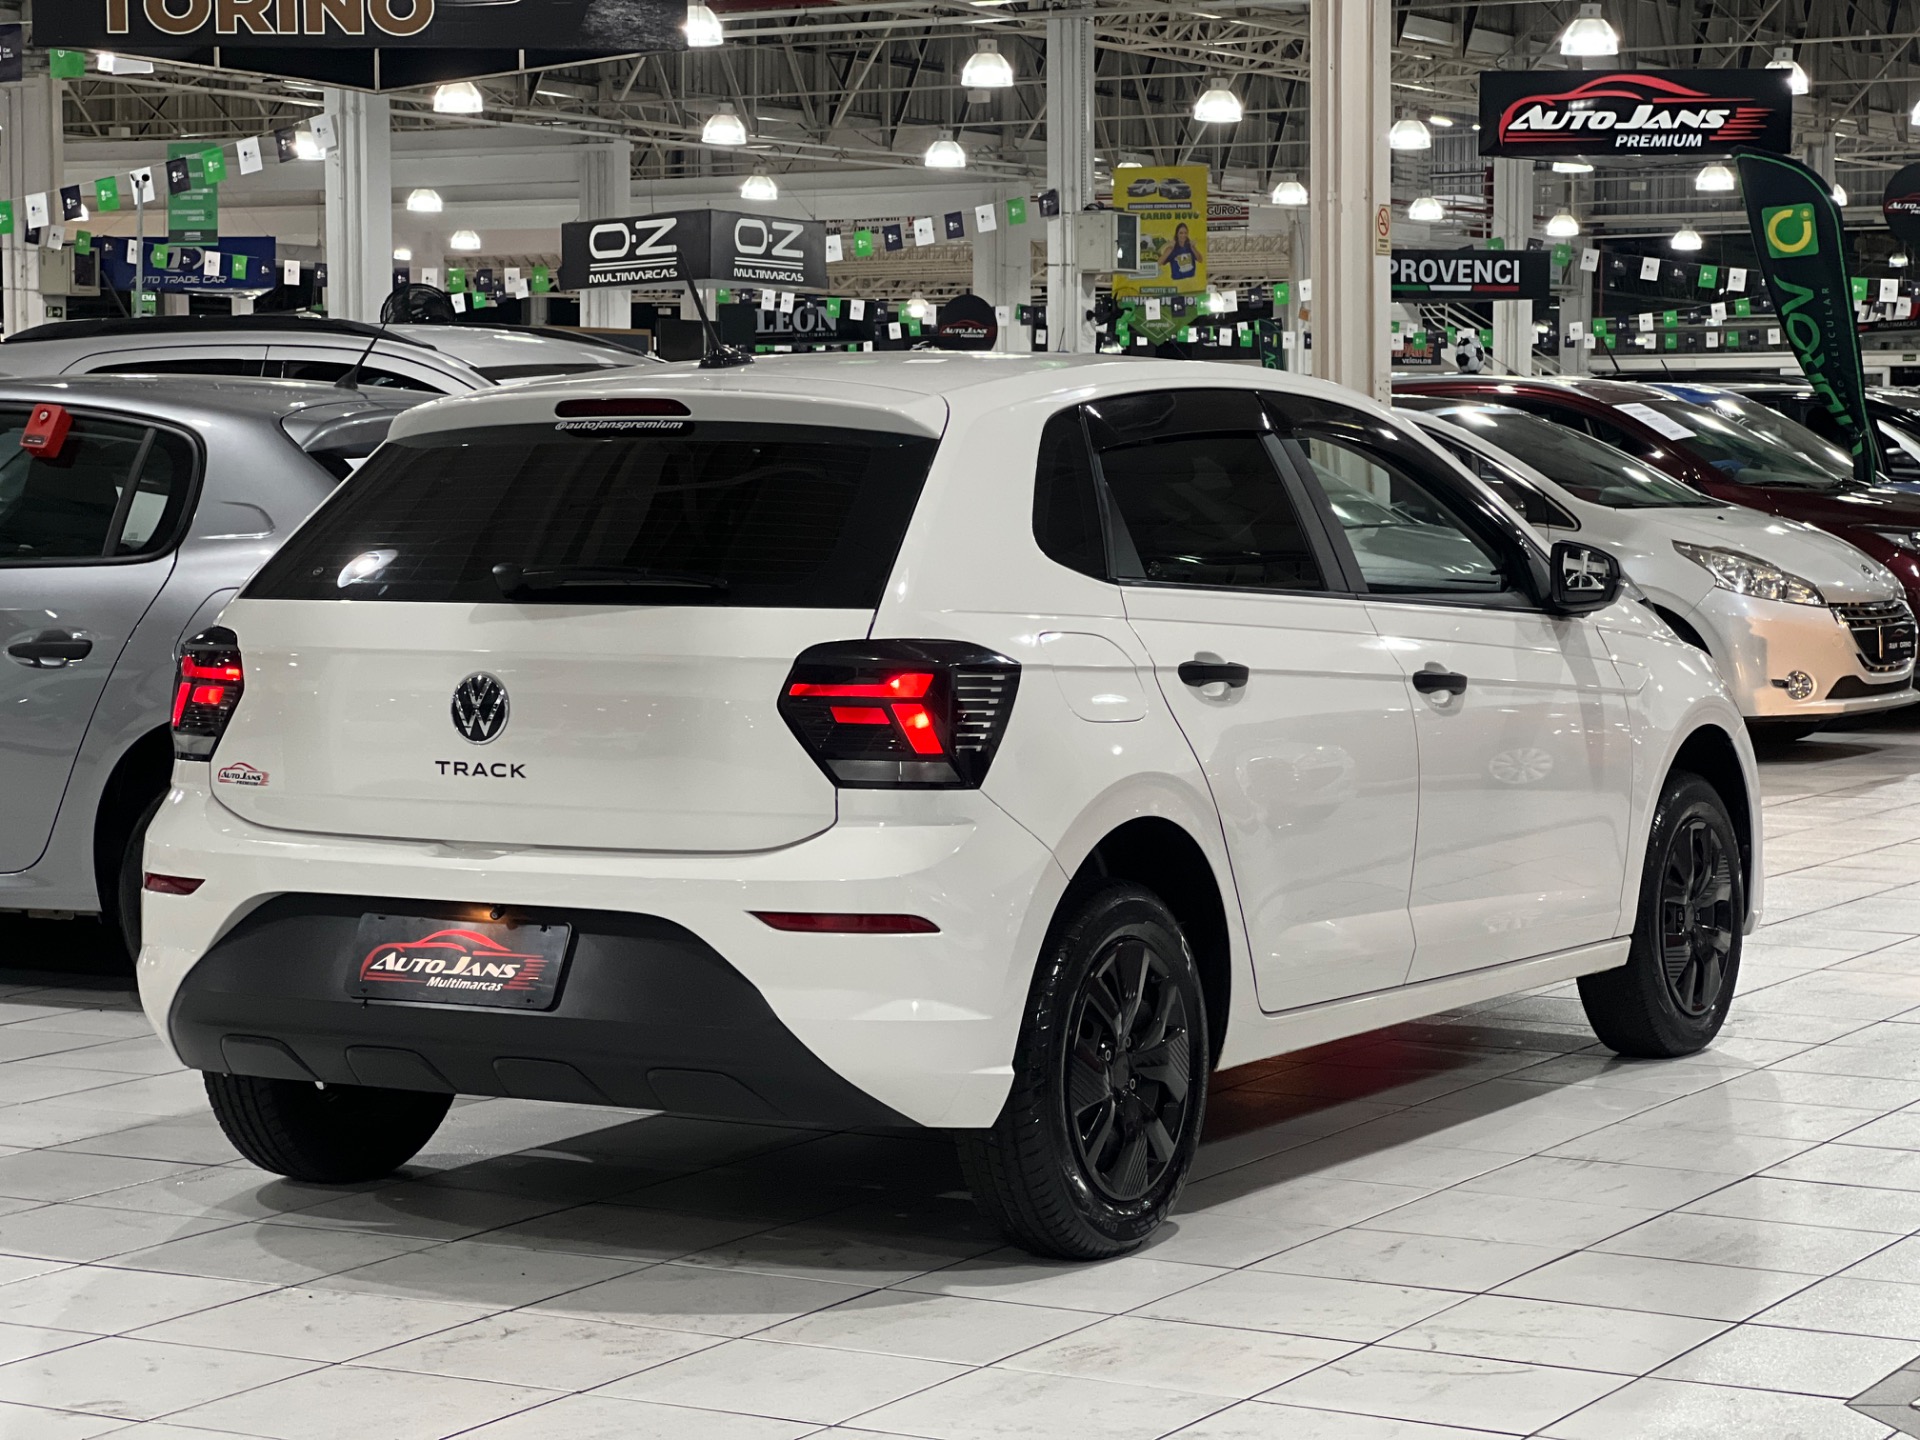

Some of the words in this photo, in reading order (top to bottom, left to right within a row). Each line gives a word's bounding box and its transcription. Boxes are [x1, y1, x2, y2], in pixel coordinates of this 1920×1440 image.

[1615, 133, 1702, 148] PREMIUM
[164, 275, 200, 284] TRADE
[202, 275, 228, 284] CAR
[589, 268, 677, 283] MULTIMARCAS
[734, 267, 804, 282] MULTIMARCAS
[754, 306, 837, 333] LEON
[555, 420, 683, 430] @autojanspremium
[435, 760, 527, 778] TRACK
[425, 976, 503, 991] Multimarcas
